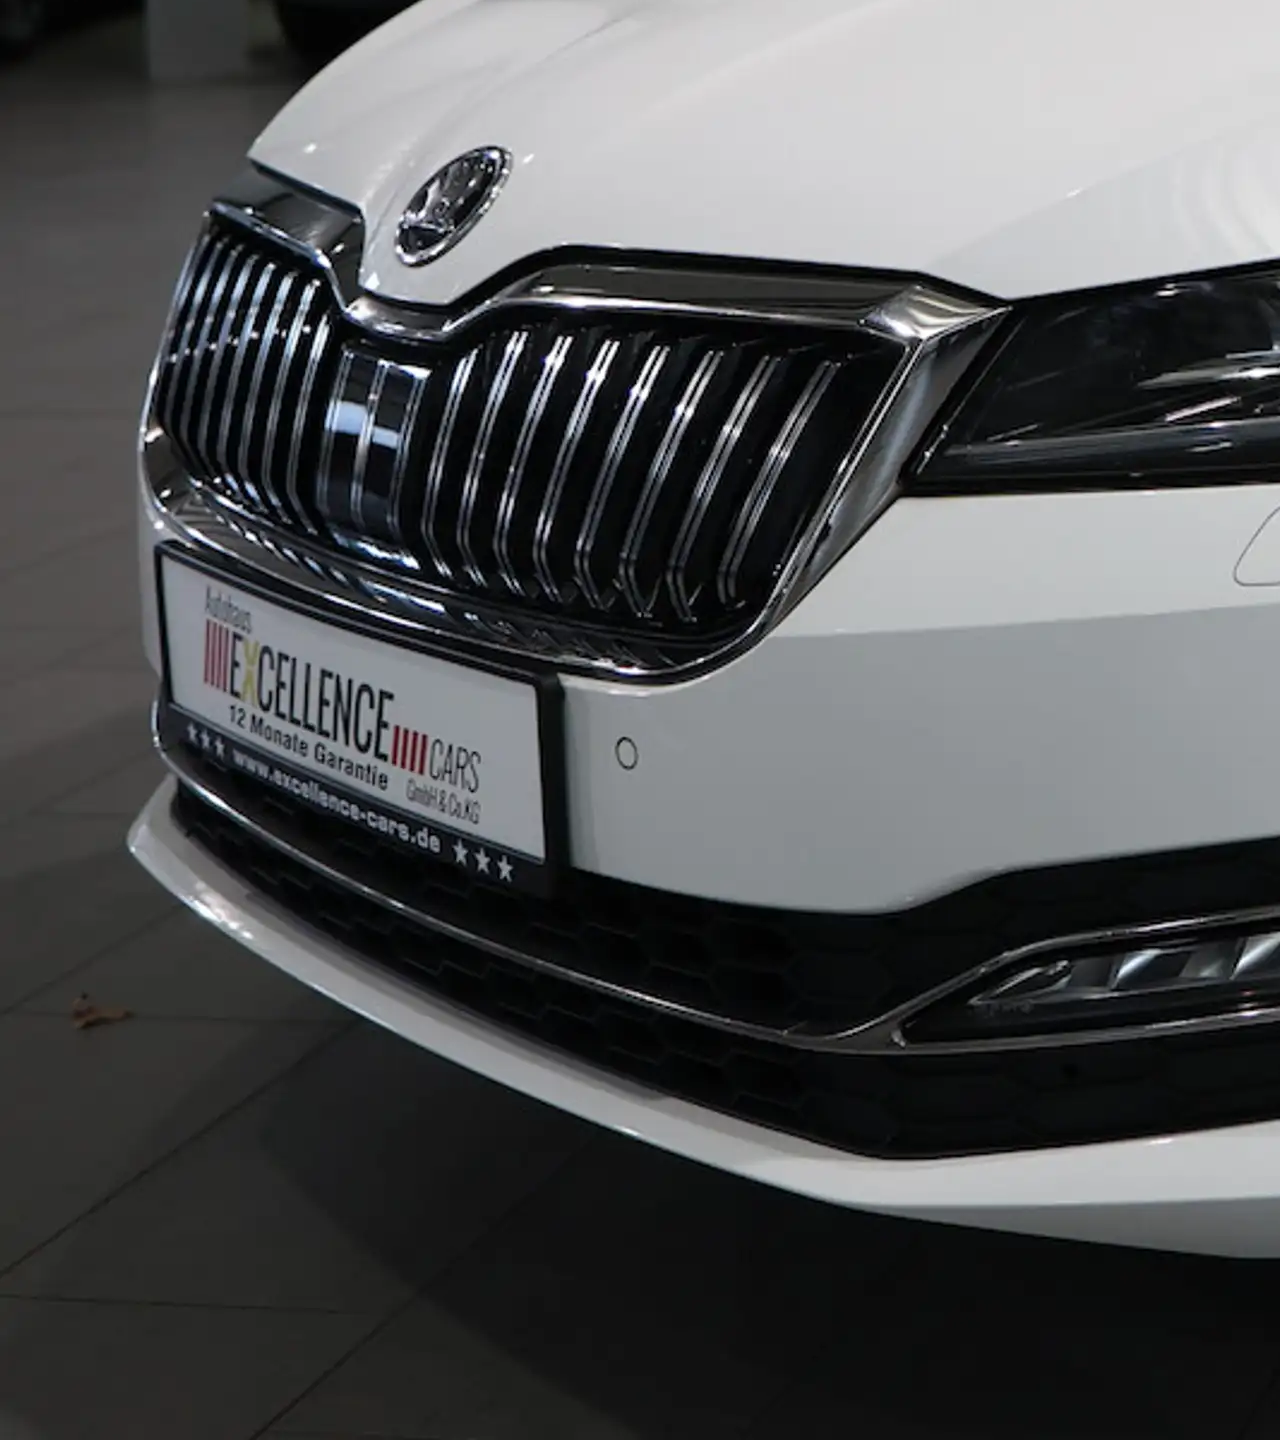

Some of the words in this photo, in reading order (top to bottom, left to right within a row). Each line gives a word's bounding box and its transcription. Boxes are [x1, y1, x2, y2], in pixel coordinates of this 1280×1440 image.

[229, 631, 395, 762] EXCELLENCE
[429, 738, 481, 793] CARS
[230, 704, 247, 729] 12
[250, 713, 309, 760] Monate
[314, 741, 388, 791] Garantie
[231, 747, 441, 853] www.excellence-cars.de
